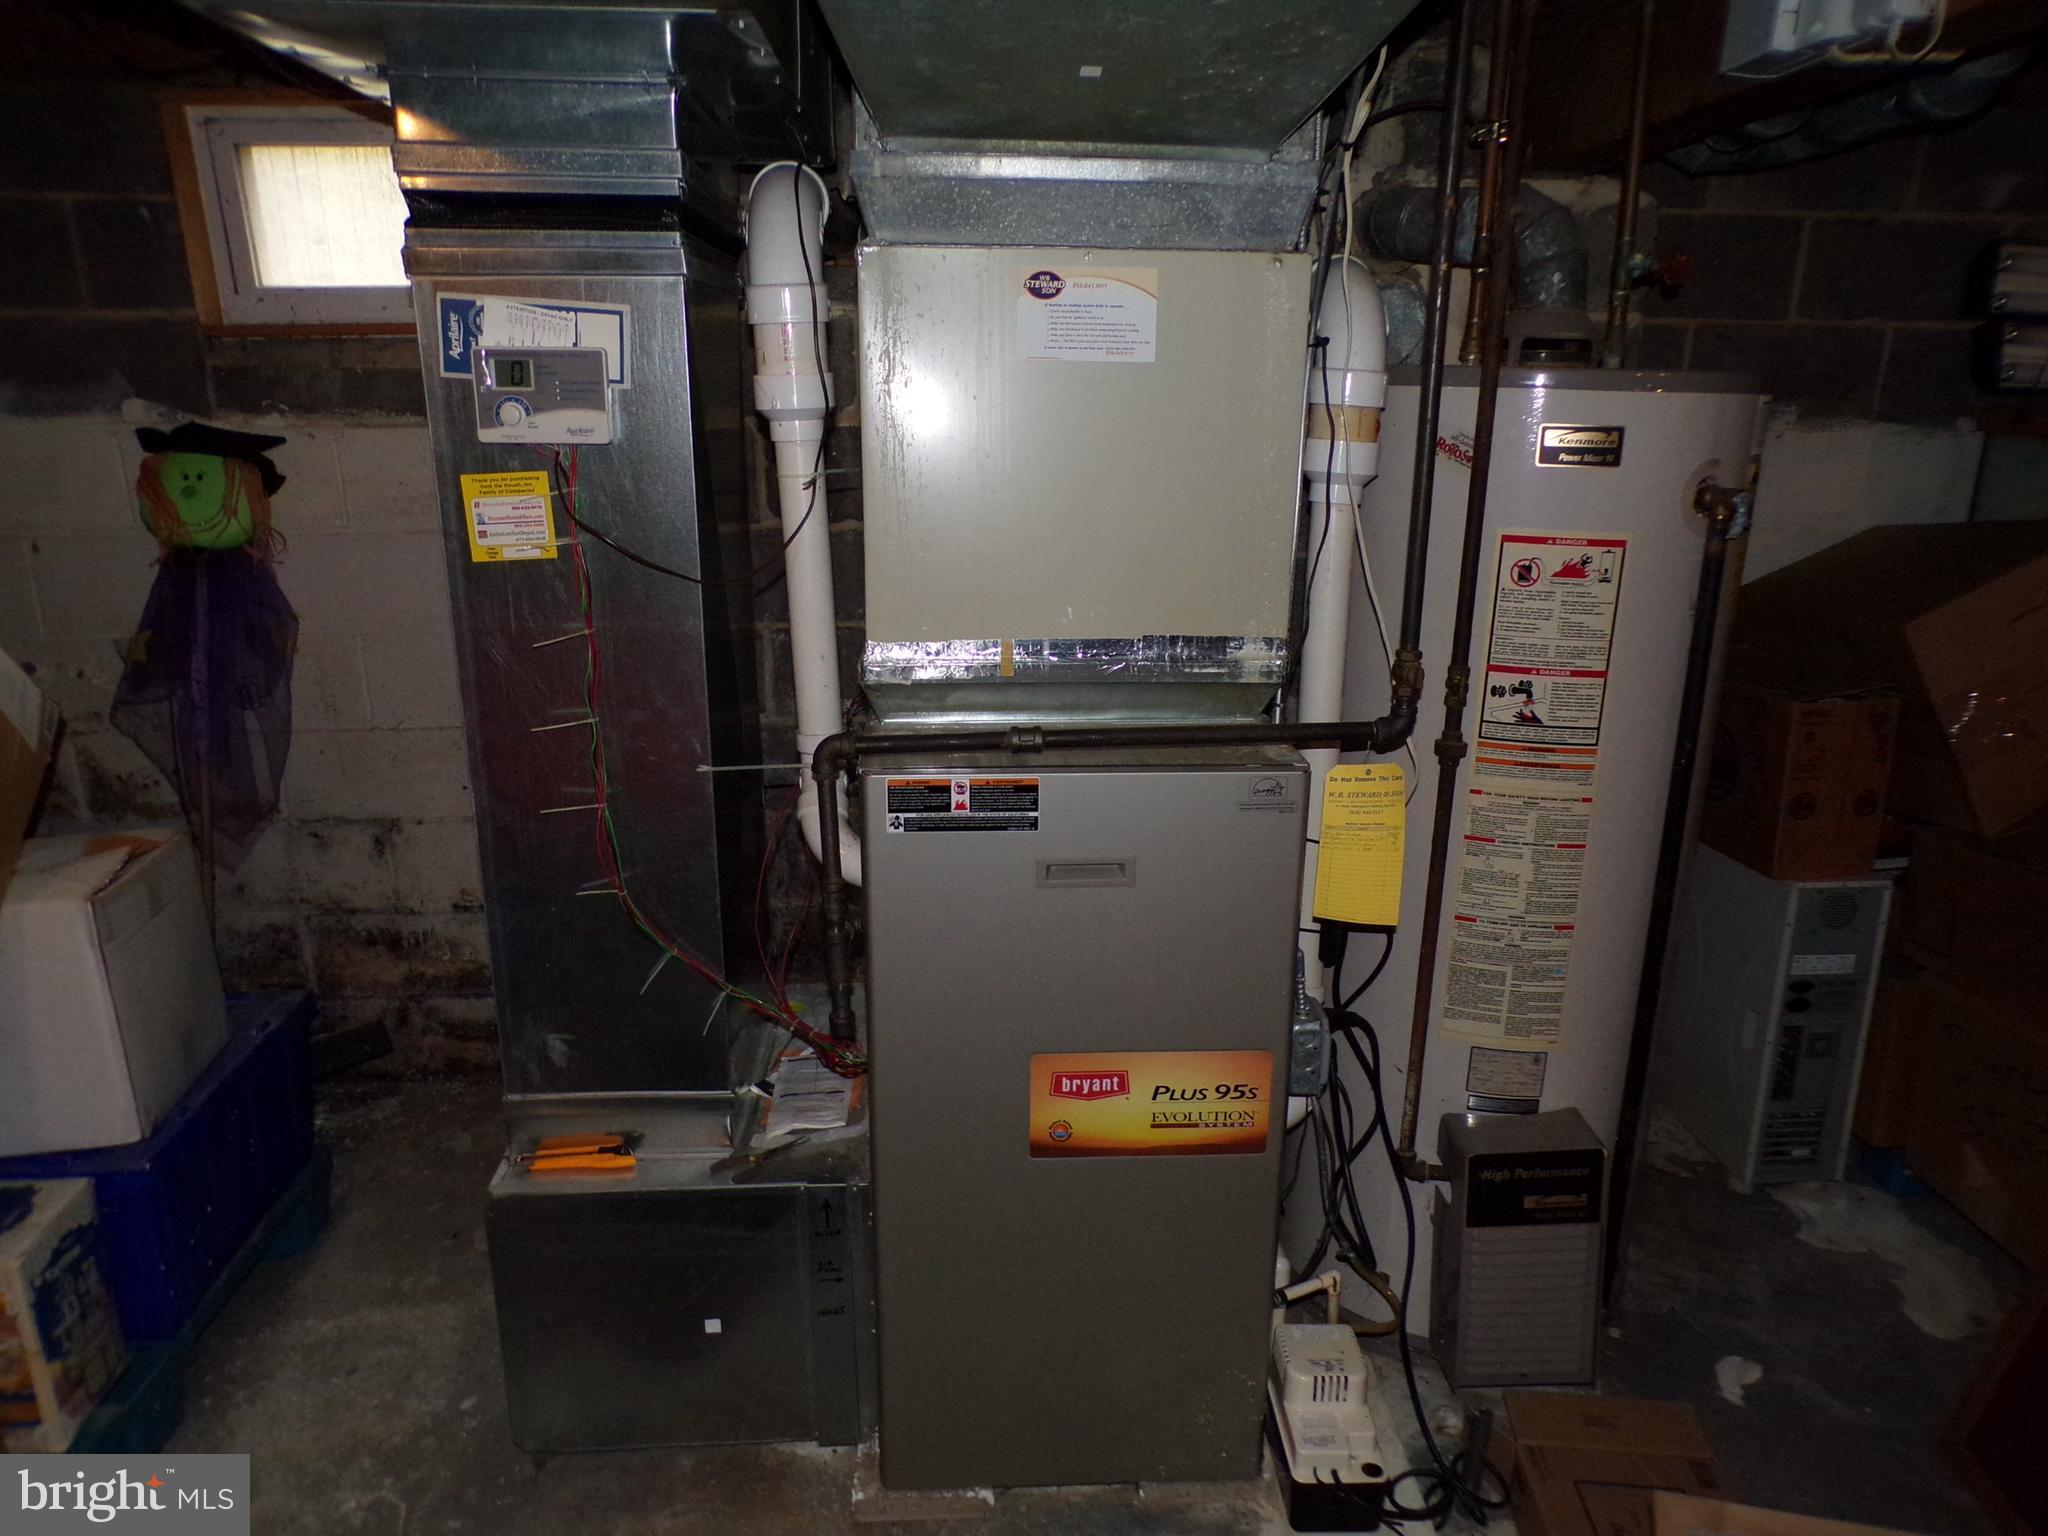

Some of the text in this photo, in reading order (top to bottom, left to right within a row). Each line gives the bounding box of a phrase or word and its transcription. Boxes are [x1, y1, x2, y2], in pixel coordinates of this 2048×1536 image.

[1024, 280, 1066, 288] STEWARD
[449, 312, 461, 360] Aprilaire
[511, 361, 524, 386] 0
[1558, 437, 1617, 447] Kenmore
[1558, 453, 1582, 462] Power
[1346, 791, 1382, 799] STEWARD
[1061, 1076, 1120, 1094] bryant
[1151, 1110, 1255, 1123] EVOLUTION
[1481, 1167, 1591, 1182] High Performance
